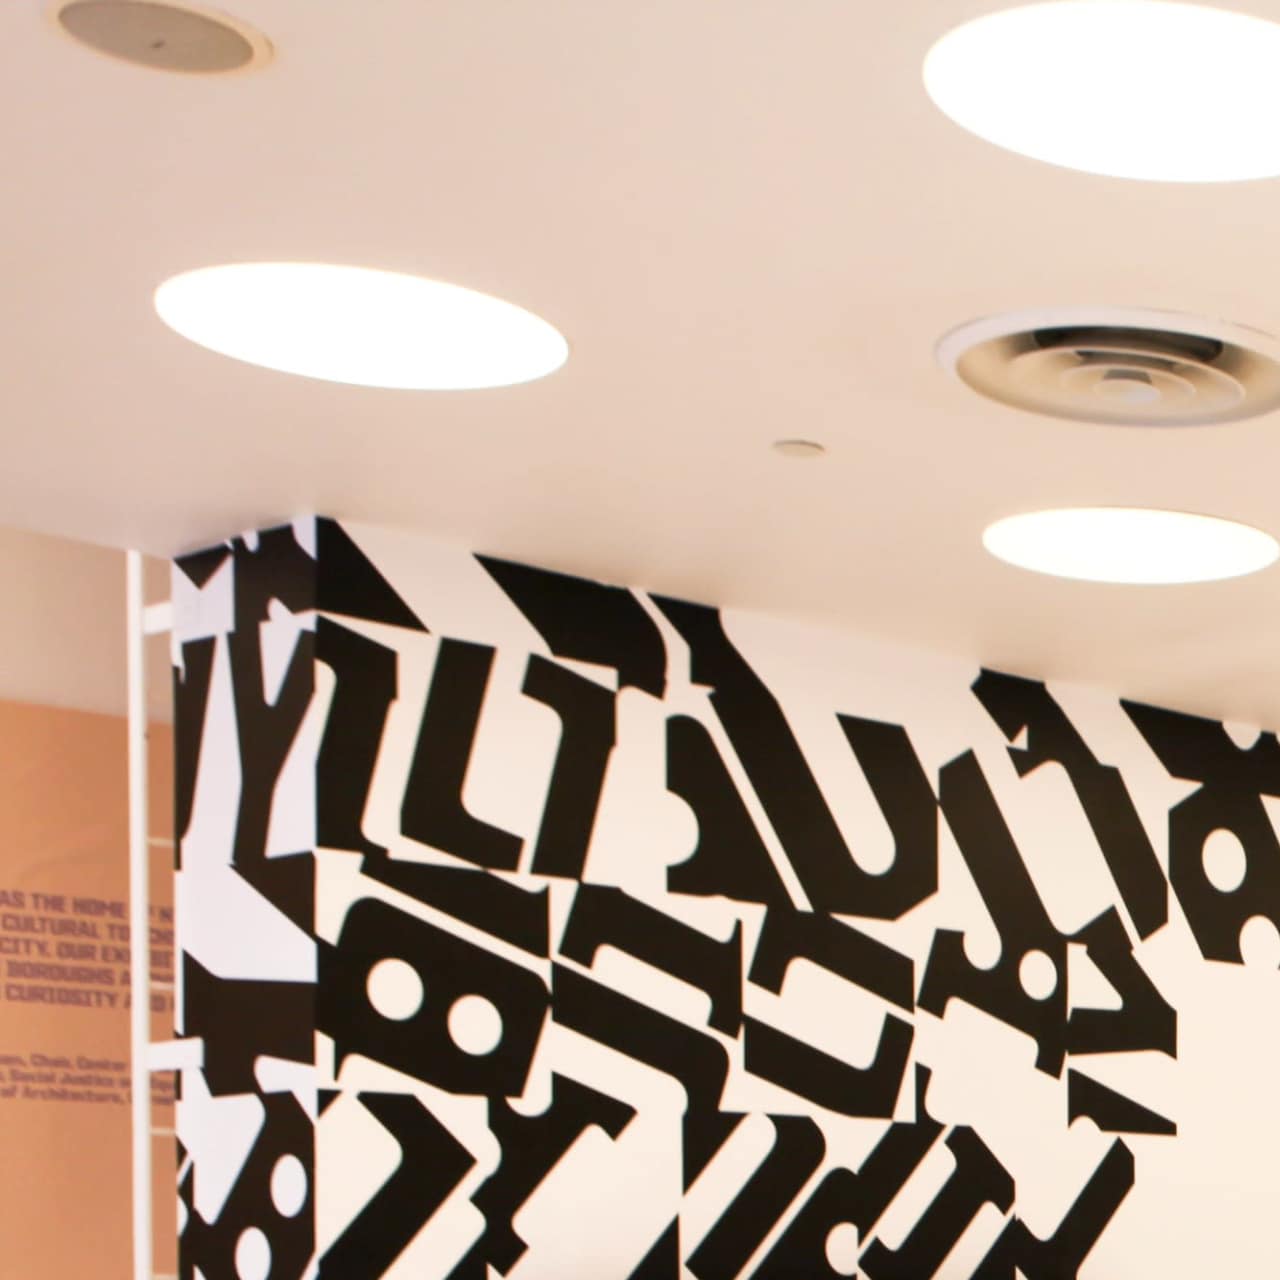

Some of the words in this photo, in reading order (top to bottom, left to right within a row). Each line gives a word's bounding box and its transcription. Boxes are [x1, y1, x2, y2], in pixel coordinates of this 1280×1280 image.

[32, 893, 65, 913] THE
[73, 897, 125, 919] HOME
[2, 913, 100, 940] CULTURAL
[56, 941, 96, 961] OUR
[6, 960, 116, 985] BOROUGHS
[5, 983, 117, 1009] CURIOSITY
